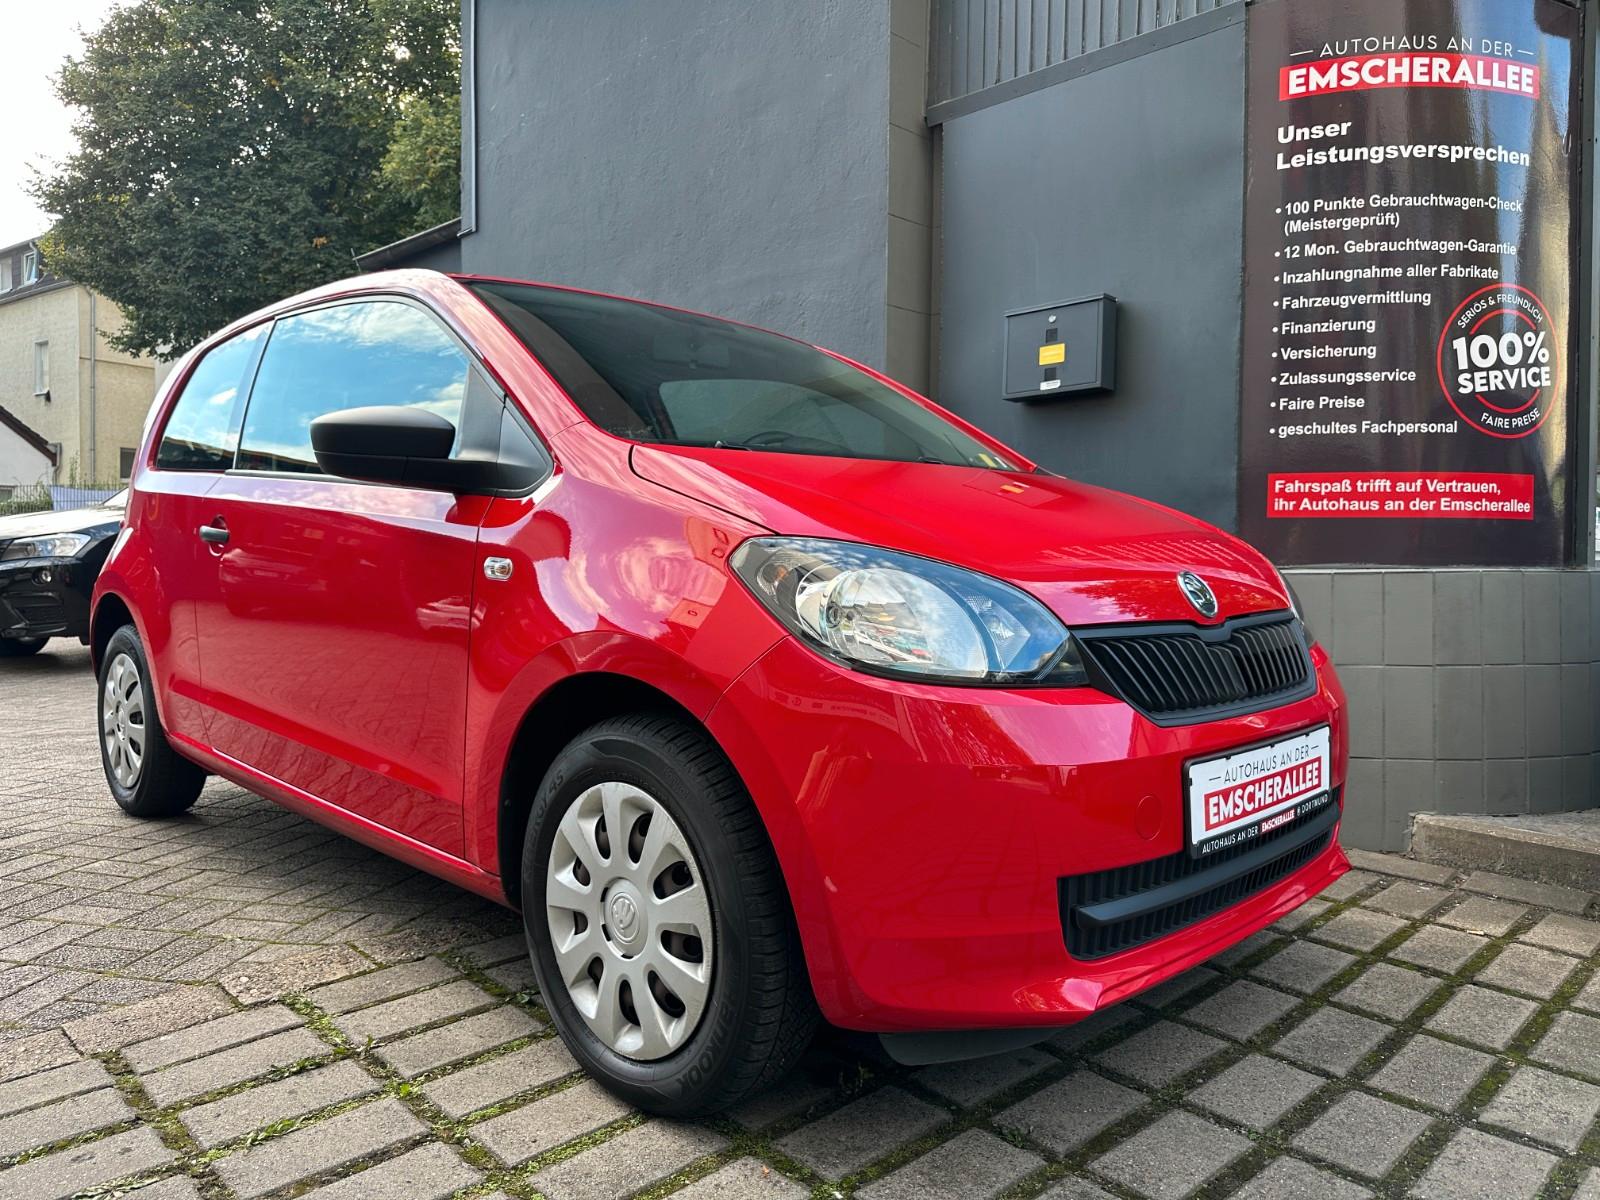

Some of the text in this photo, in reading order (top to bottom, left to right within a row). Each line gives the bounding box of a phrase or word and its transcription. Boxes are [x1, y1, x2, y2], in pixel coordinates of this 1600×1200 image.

[1320, 35, 1512, 57] AUTOHAUS AN DER
[1288, 57, 1534, 95] EMSCHERALLEE
[1277, 121, 1352, 144] Unser
[1277, 144, 1530, 170] Leistungsversprechen
[1285, 194, 1522, 215] 100 Punkte Gebrauchtwagen-Check
[1284, 213, 1399, 236] (Meistergeprüft)
[1284, 239, 1517, 258] 12 Mon. Gebrauchtwagen-Garantie
[1283, 264, 1498, 284] Inzahlungnahme aller Fabrikate
[1282, 292, 1431, 309] Fahrzeugvermittlung
[1488, 296, 1495, 305] &
[1497, 294, 1543, 323] FREUNDLICH
[1282, 319, 1376, 335] Finanzierung
[1281, 344, 1377, 360] Versicherung
[1453, 332, 1549, 370] 100%
[1279, 370, 1416, 386] Zulassungsservice
[1458, 367, 1551, 394] SERVICE
[1279, 395, 1365, 411] Faire Preise
[1481, 408, 1540, 428] FAIRE PREISE
[1278, 420, 1458, 439] geschultes Fachpersonal
[1275, 479, 1501, 497] Fahrspaß trifft auf Vertrauen,
[1274, 498, 1530, 512] ihr Autohaus an der Emscherallee
[1224, 745, 1309, 784] AUTOHAUS AN DER
[1209, 762, 1319, 825] EMSCHERALLEE
[1202, 794, 1328, 854] AUTOHAUS AN DER EMSCHERALLEE DORTMUND
